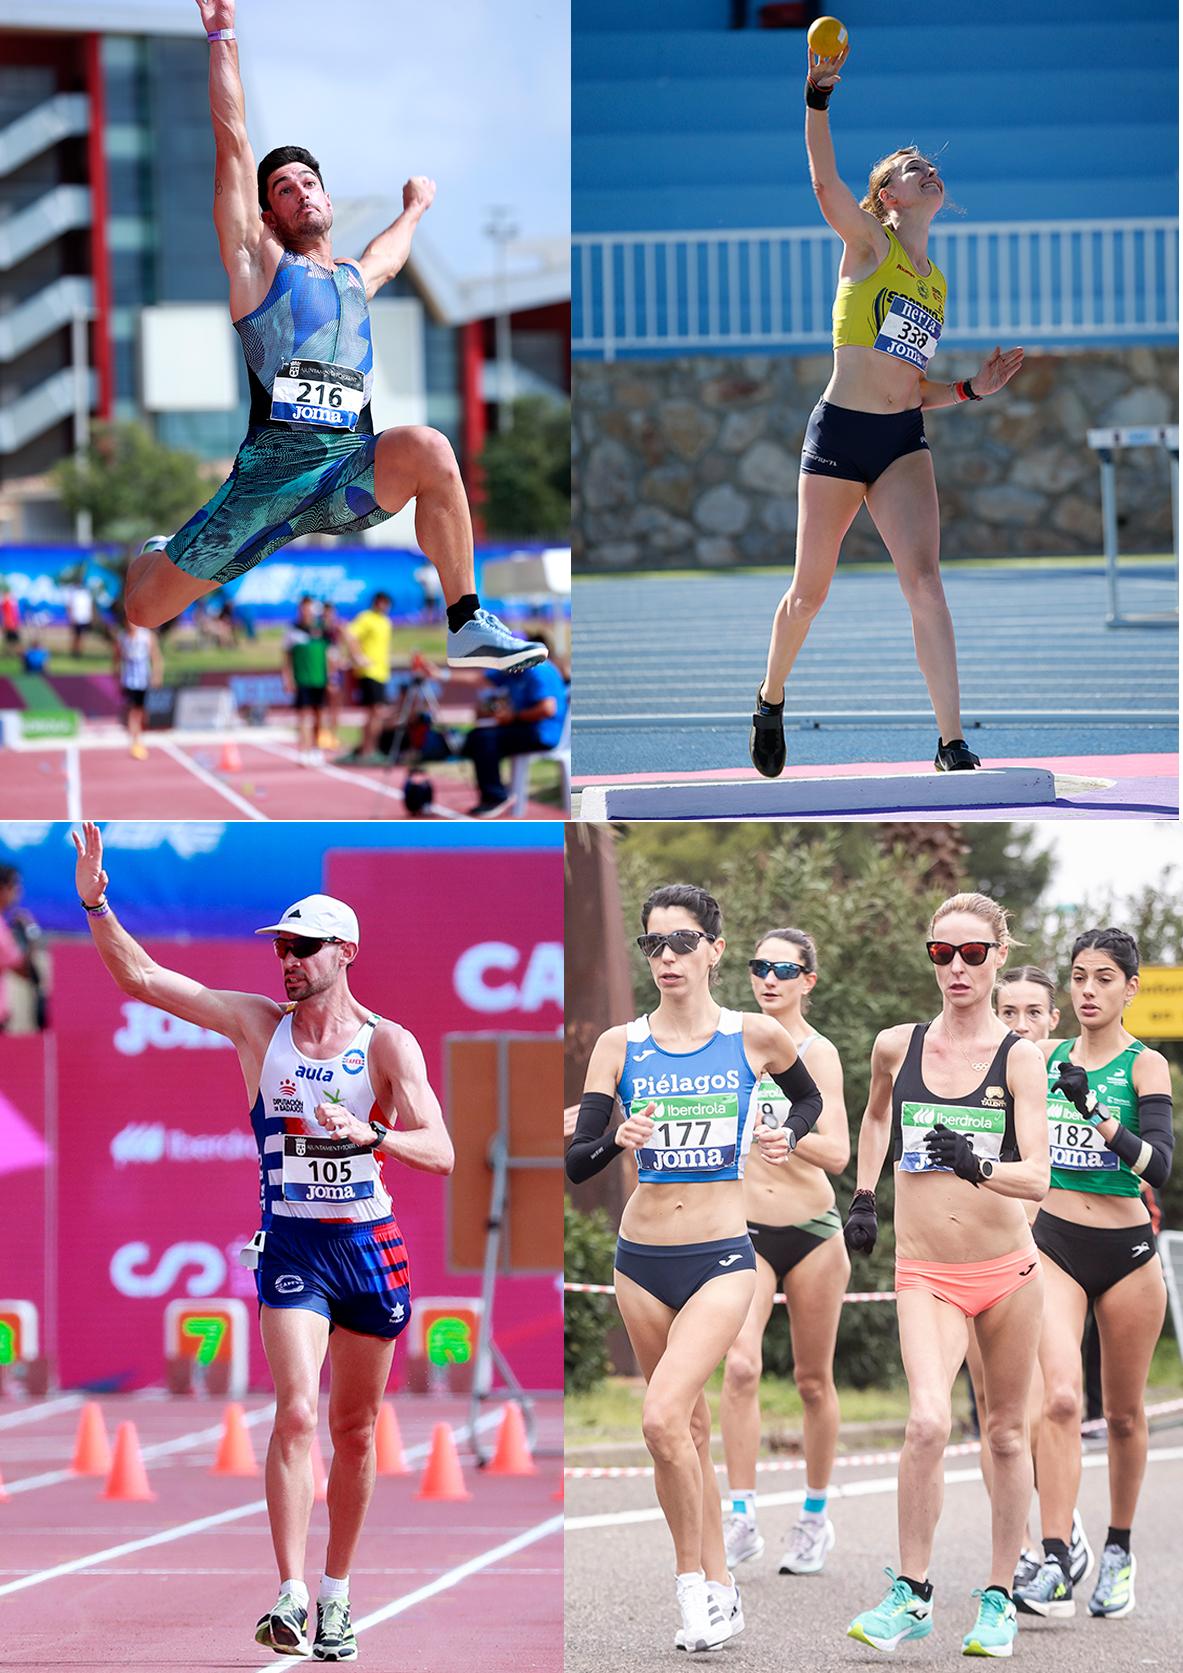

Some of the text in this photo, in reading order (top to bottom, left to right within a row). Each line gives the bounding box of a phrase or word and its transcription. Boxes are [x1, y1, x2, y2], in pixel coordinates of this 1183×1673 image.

[898, 321, 929, 350] 338
[296, 382, 343, 408] 216
[292, 405, 343, 423] Joma
[295, 1065, 334, 1082] aula
[667, 1103, 726, 1118] Iberdrola
[936, 1112, 993, 1129] Iberdrola
[657, 1120, 712, 1148] 177
[1054, 1124, 1094, 1149] 182
[653, 1148, 724, 1171] Joma
[308, 1160, 352, 1183] 105
[306, 1185, 355, 1200] Joma
[183, 1317, 226, 1366] 7
